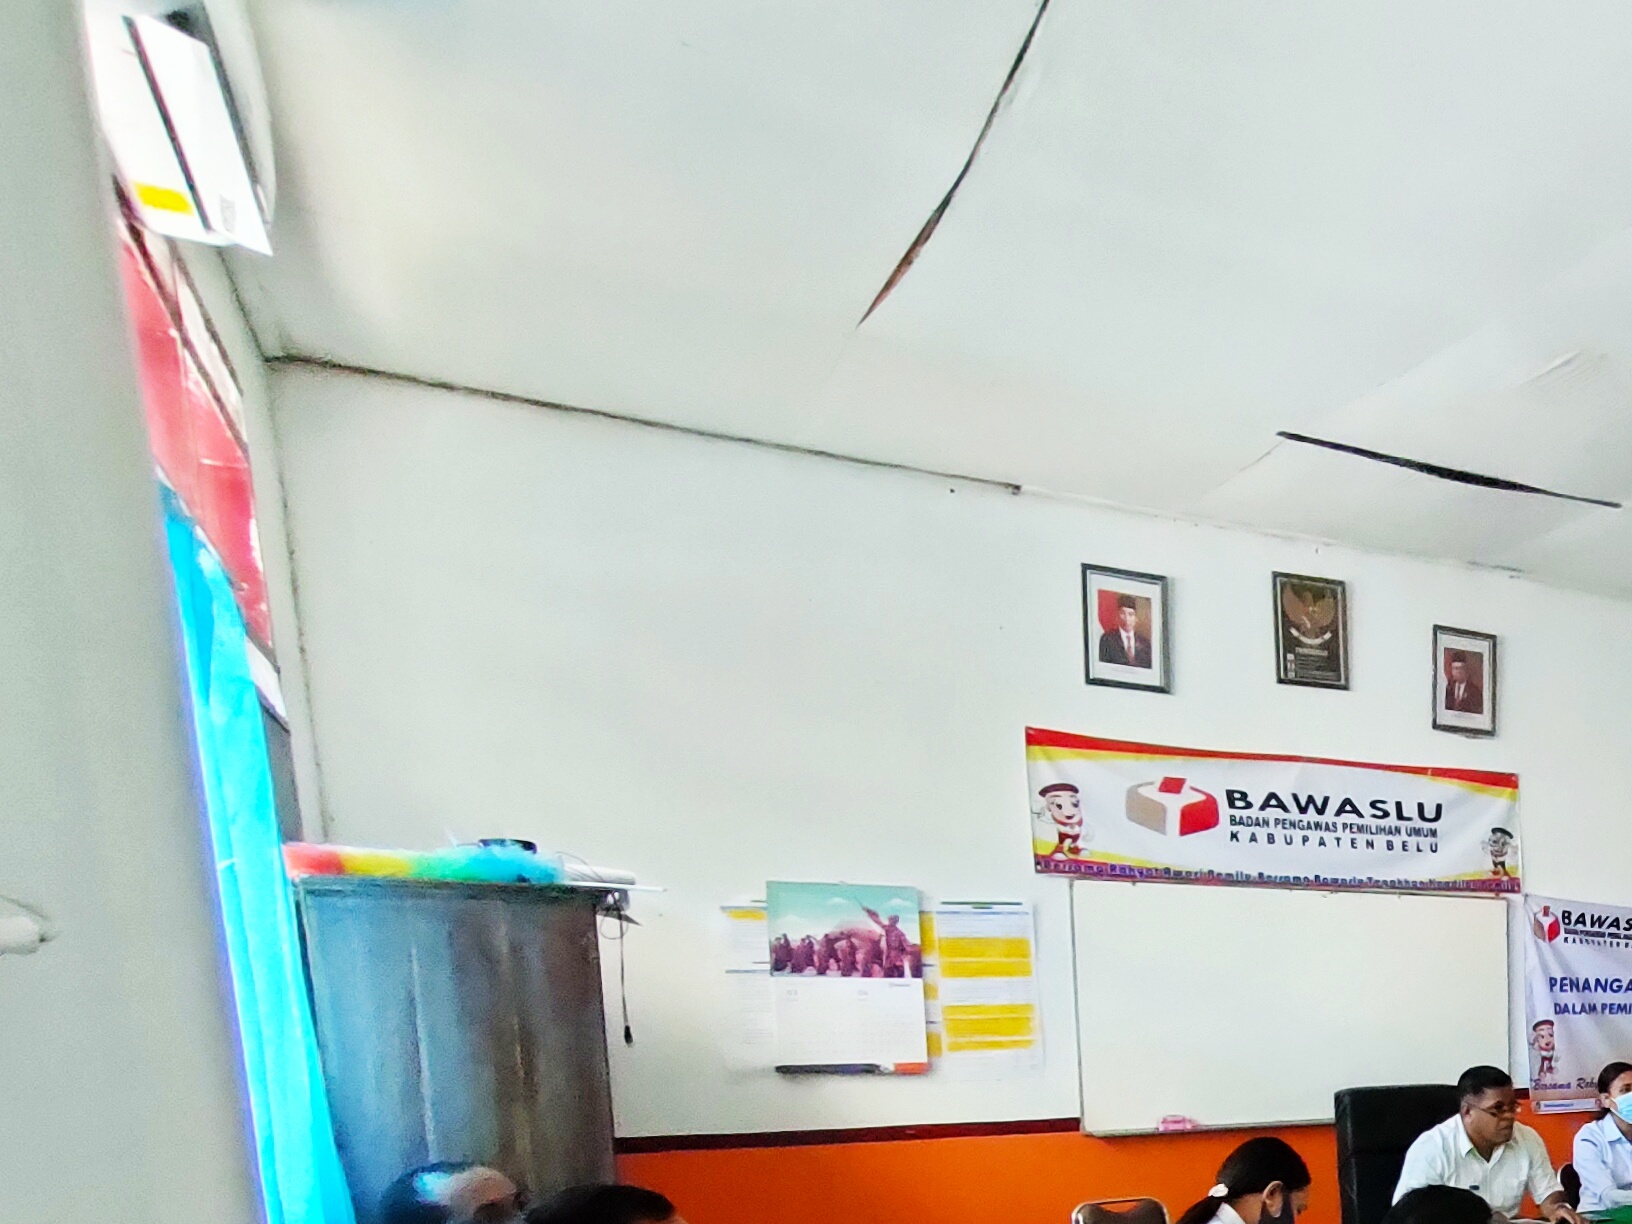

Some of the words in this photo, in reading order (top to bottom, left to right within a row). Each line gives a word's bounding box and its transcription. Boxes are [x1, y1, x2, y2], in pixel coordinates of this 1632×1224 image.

[1225, 789, 1443, 823] BAWASLU
[1229, 814, 1270, 829] BADAN
[1274, 818, 1338, 834] PENGAWAS
[1342, 823, 1401, 837] PEMILIHAN
[1405, 826, 1438, 839] UMUM
[1229, 830, 1375, 850] KABUPATEN
[1386, 840, 1439, 854] BELU
[1553, 1002, 1598, 1015] DALAM
